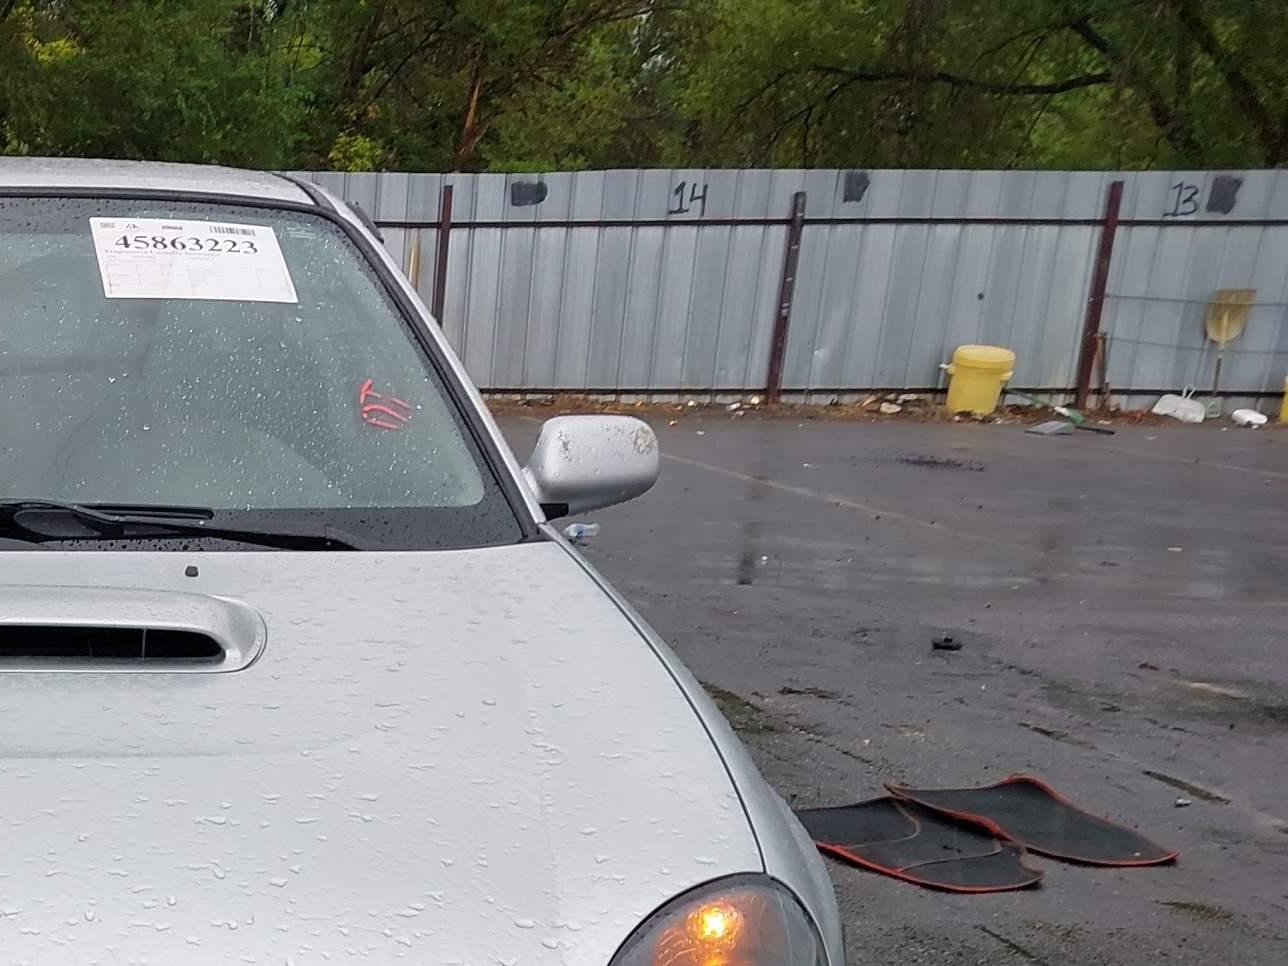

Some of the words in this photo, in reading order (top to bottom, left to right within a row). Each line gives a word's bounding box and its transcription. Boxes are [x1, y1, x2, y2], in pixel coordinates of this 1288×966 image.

[668, 181, 708, 217] 14
[1163, 181, 1199, 217] 13
[114, 234, 258, 254] 45863223
